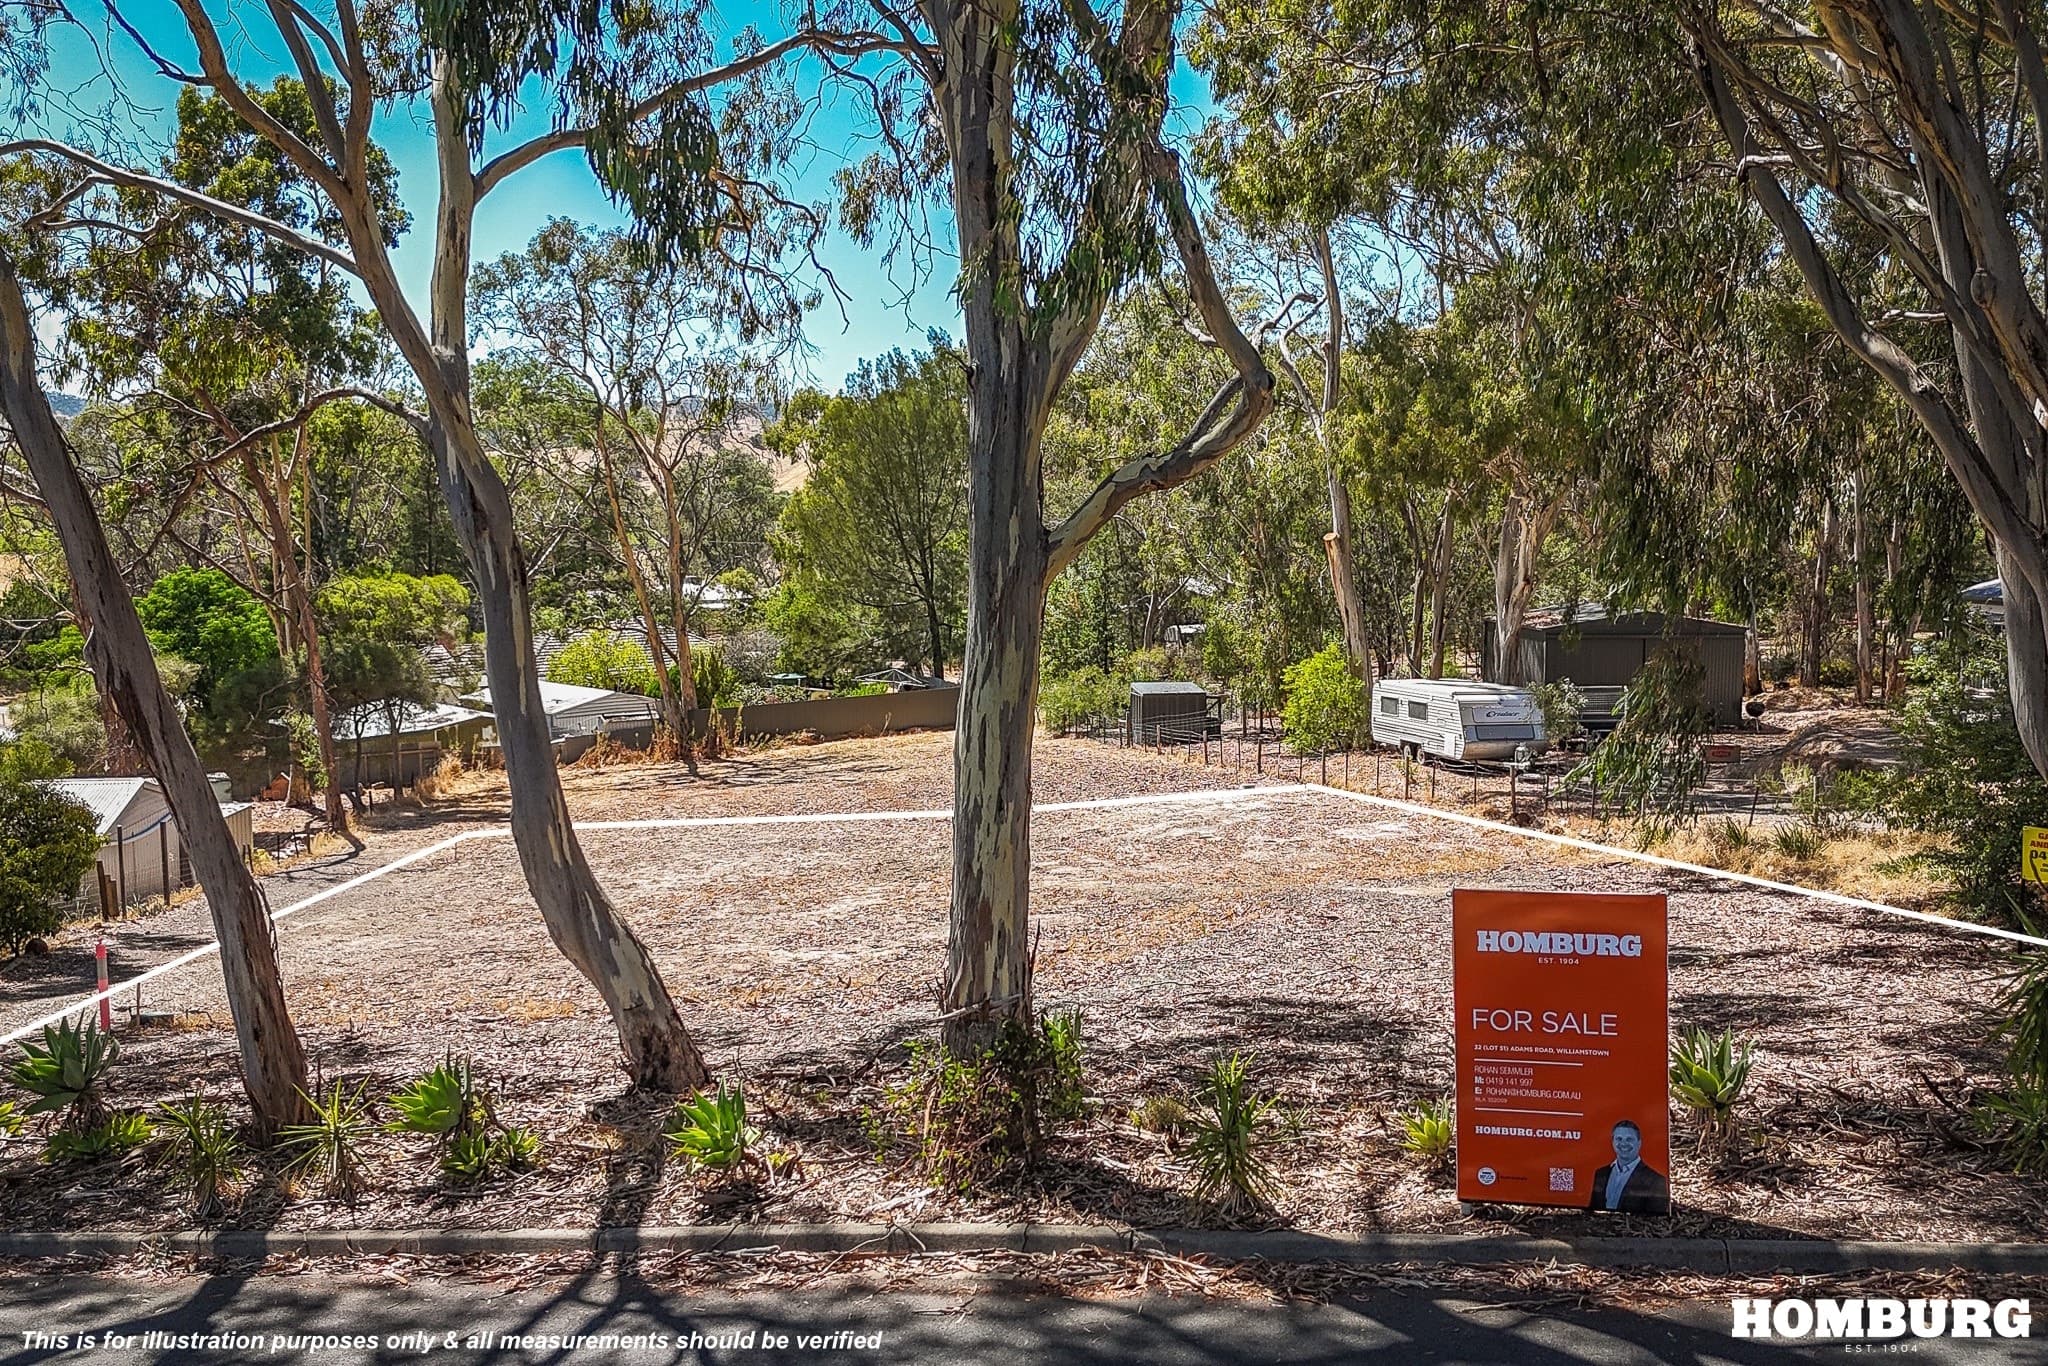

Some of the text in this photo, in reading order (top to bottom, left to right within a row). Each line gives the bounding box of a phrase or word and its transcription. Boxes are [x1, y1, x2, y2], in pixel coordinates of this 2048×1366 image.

[1477, 930, 1642, 957] HOMBURG
[1538, 957, 1556, 965] EST.
[1472, 1008, 1618, 1036] FOR SALE
[1556, 1048, 1610, 1057] WILLIAMSTOWN
[1474, 1065, 1533, 1076] ROHAN SEMMLER
[1474, 1076, 1484, 1084] M:
[1485, 1077, 1504, 1085] 0419
[1474, 1087, 1482, 1095] E:
[1475, 1126, 1581, 1140] HOMBURG.COM.AU
